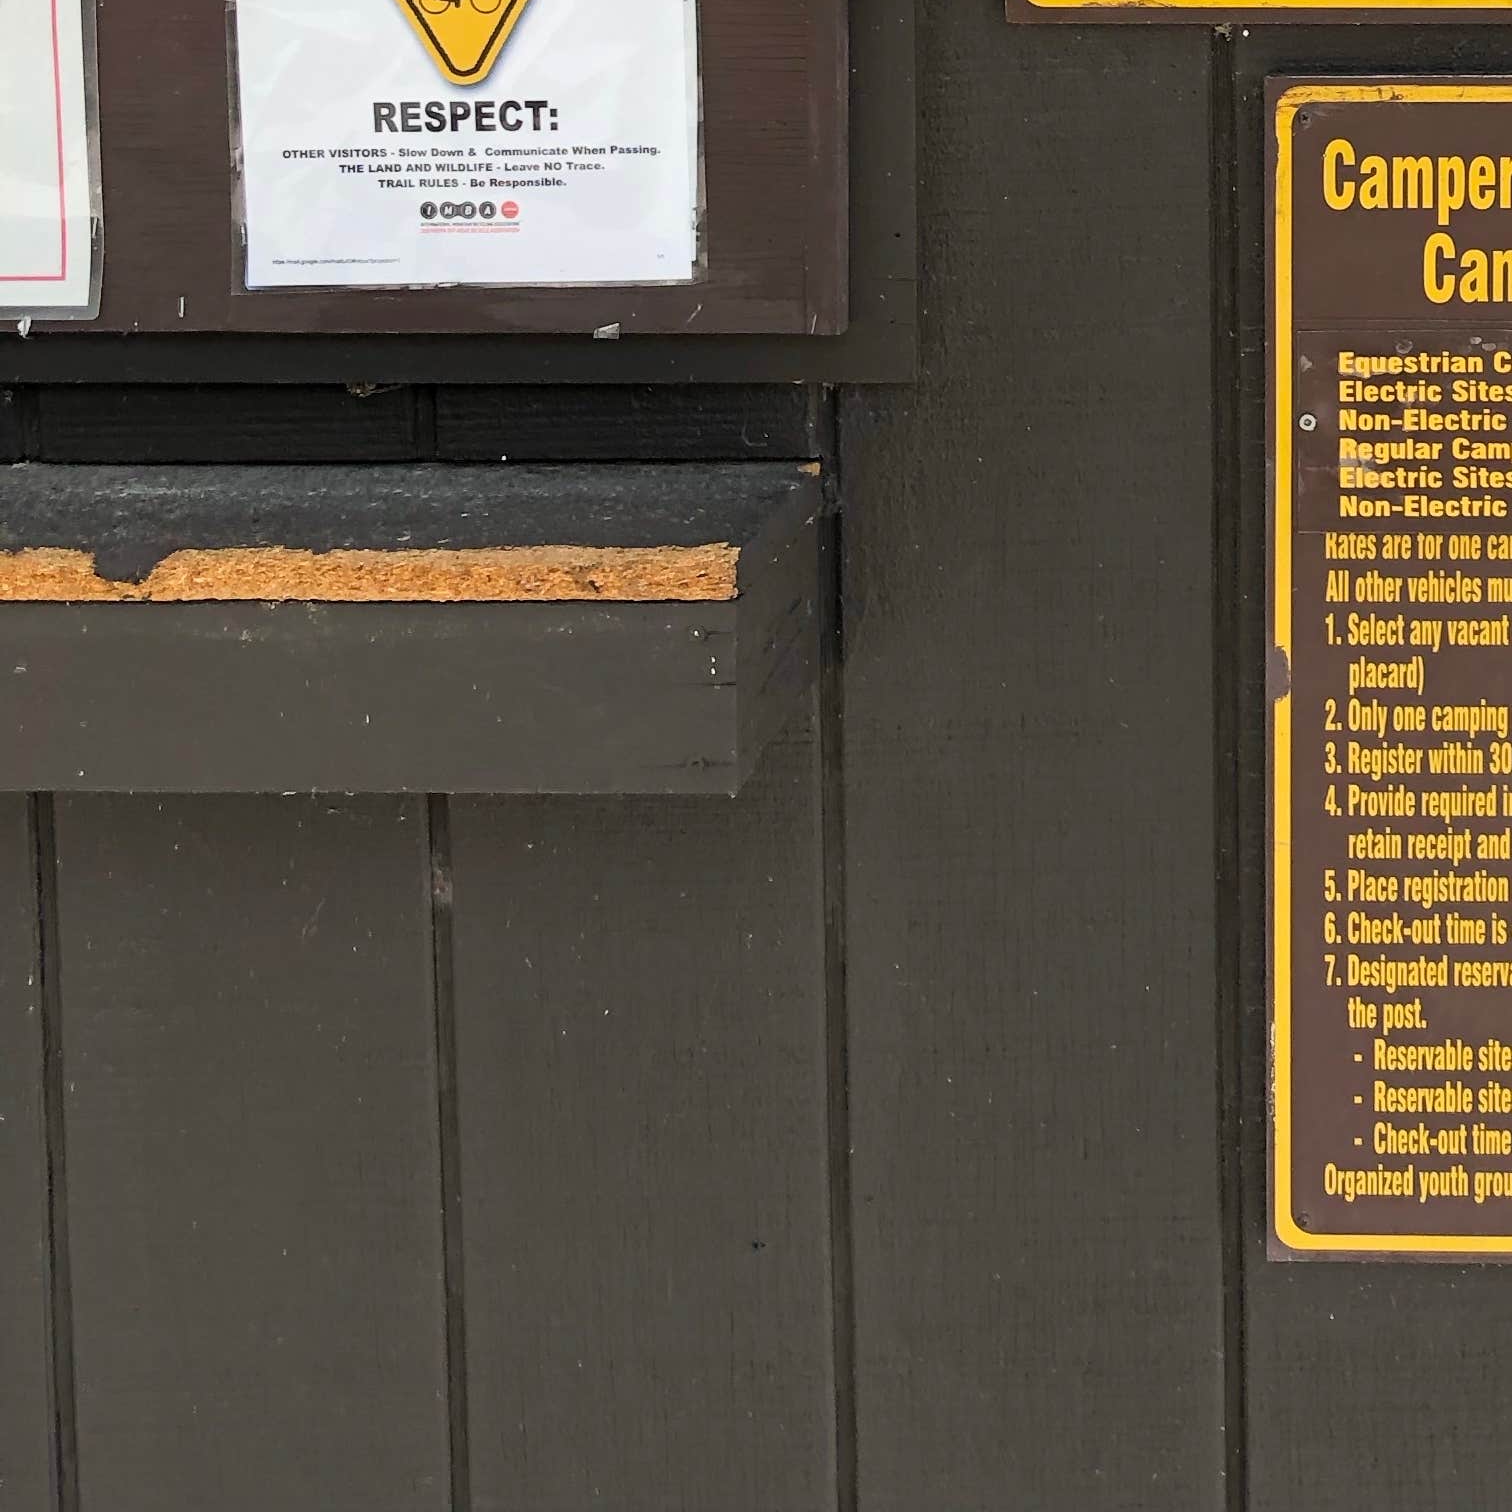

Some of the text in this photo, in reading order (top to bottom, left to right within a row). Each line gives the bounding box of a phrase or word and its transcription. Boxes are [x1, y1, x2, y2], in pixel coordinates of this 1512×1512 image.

[373, 100, 559, 133] RESPECT:
[282, 149, 325, 159] OTHER
[329, 148, 388, 158] VISITORS
[399, 147, 427, 157] Slow
[431, 147, 464, 157] Down
[467, 147, 477, 157] &
[484, 146, 569, 156] Communicate
[572, 145, 606, 155] When
[609, 144, 661, 157] Passing.
[339, 164, 365, 173] THE
[368, 164, 402, 173] LAND
[406, 163, 433, 173] AND
[435, 163, 493, 172] WILDLIFE
[504, 162, 541, 172] Leave
[544, 162, 562, 171] NO
[566, 161, 605, 171] Trace.
[378, 179, 416, 188] TRAIL
[418, 178, 459, 188] RULES
[470, 178, 486, 188] Be
[489, 177, 568, 189] Responsible.
[1337, 351, 1484, 377] Equestrian
[1339, 380, 1440, 403] Electric
[1338, 408, 1505, 432] Non-Electric
[1324, 743, 1342, 772] 3.
[1347, 742, 1424, 779] Register
[1428, 742, 1484, 774] within
[1490, 741, 1512, 773] 30
[1326, 1164, 1414, 1200] Organized
[1420, 1165, 1469, 1198] youth
